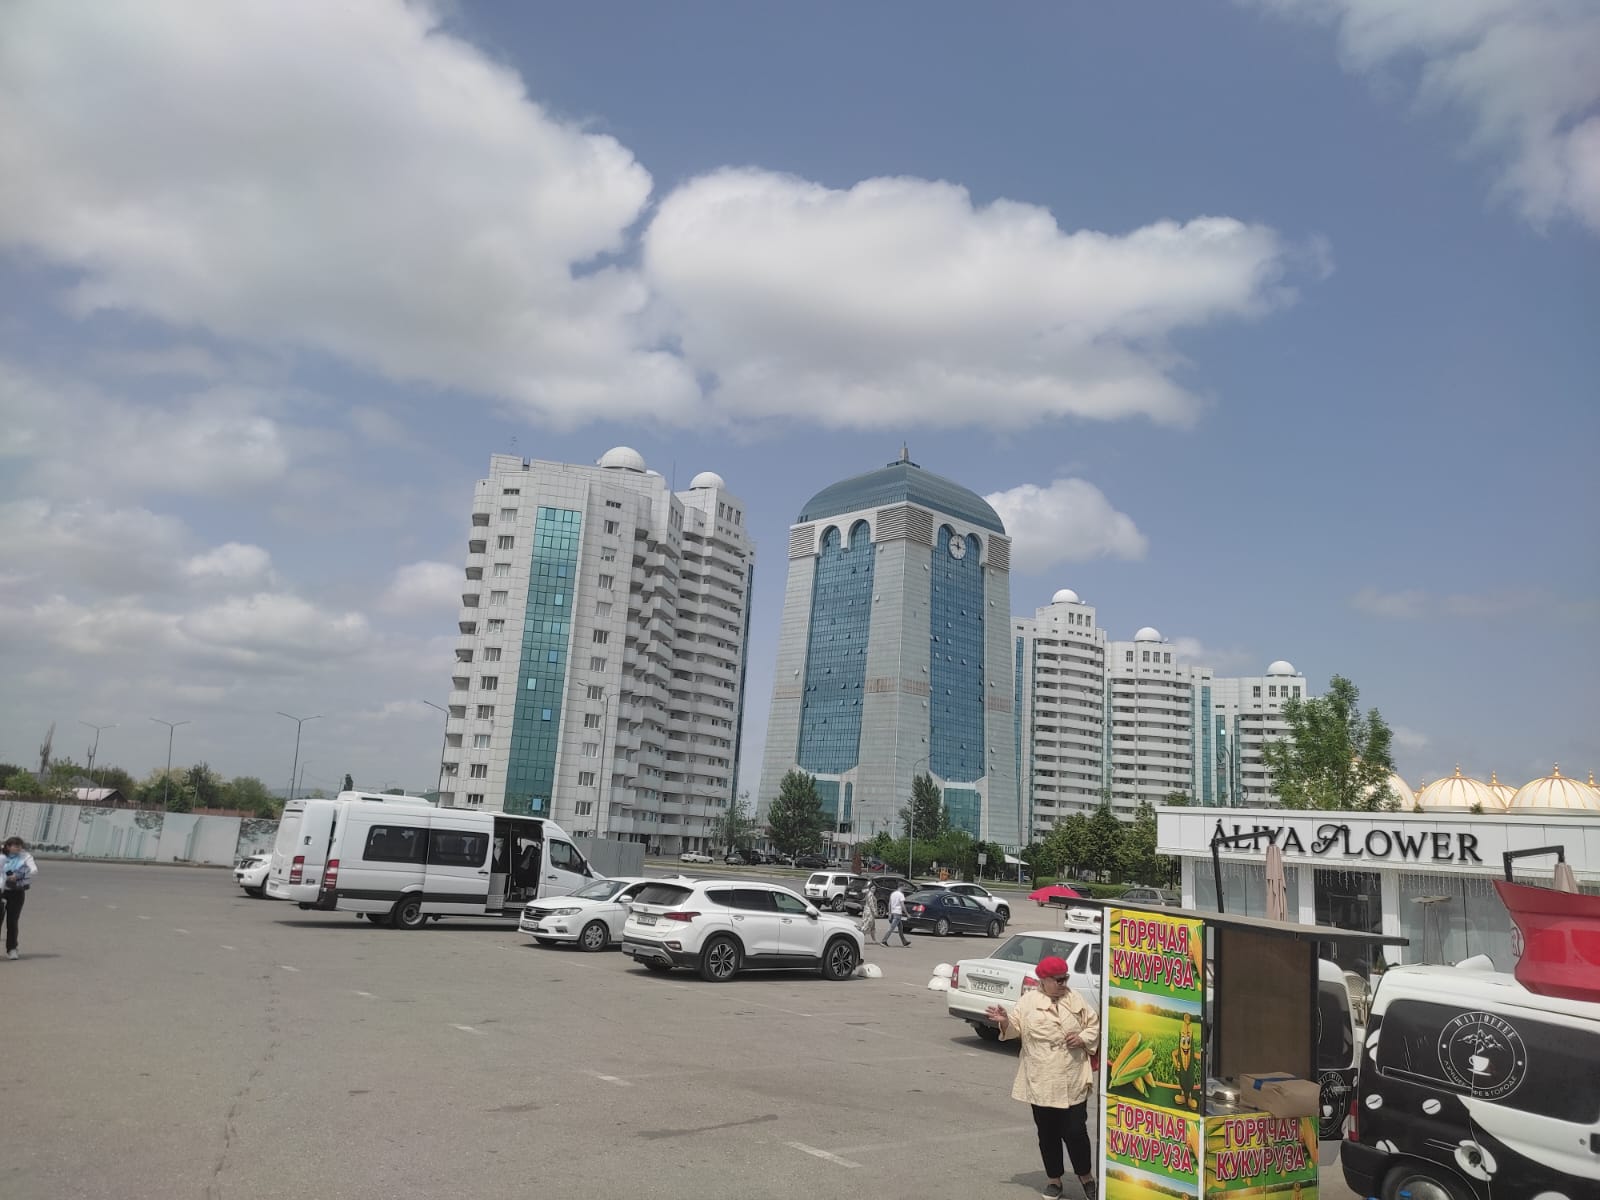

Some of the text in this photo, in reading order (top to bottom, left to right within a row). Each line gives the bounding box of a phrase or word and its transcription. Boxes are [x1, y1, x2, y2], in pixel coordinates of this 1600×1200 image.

[1311, 823, 1483, 862] FLOWER
[1119, 917, 1188, 955] ГОРЯЧАЯ
[1113, 948, 1195, 990] КУКУРУЗА
[1116, 1103, 1186, 1143] ГОРЯЧАЯ
[1224, 1118, 1299, 1147] ГОРЯЧАЯ
[1110, 1129, 1193, 1174] КУКУРУЗА
[1216, 1144, 1305, 1180] КУКУРУЗА
